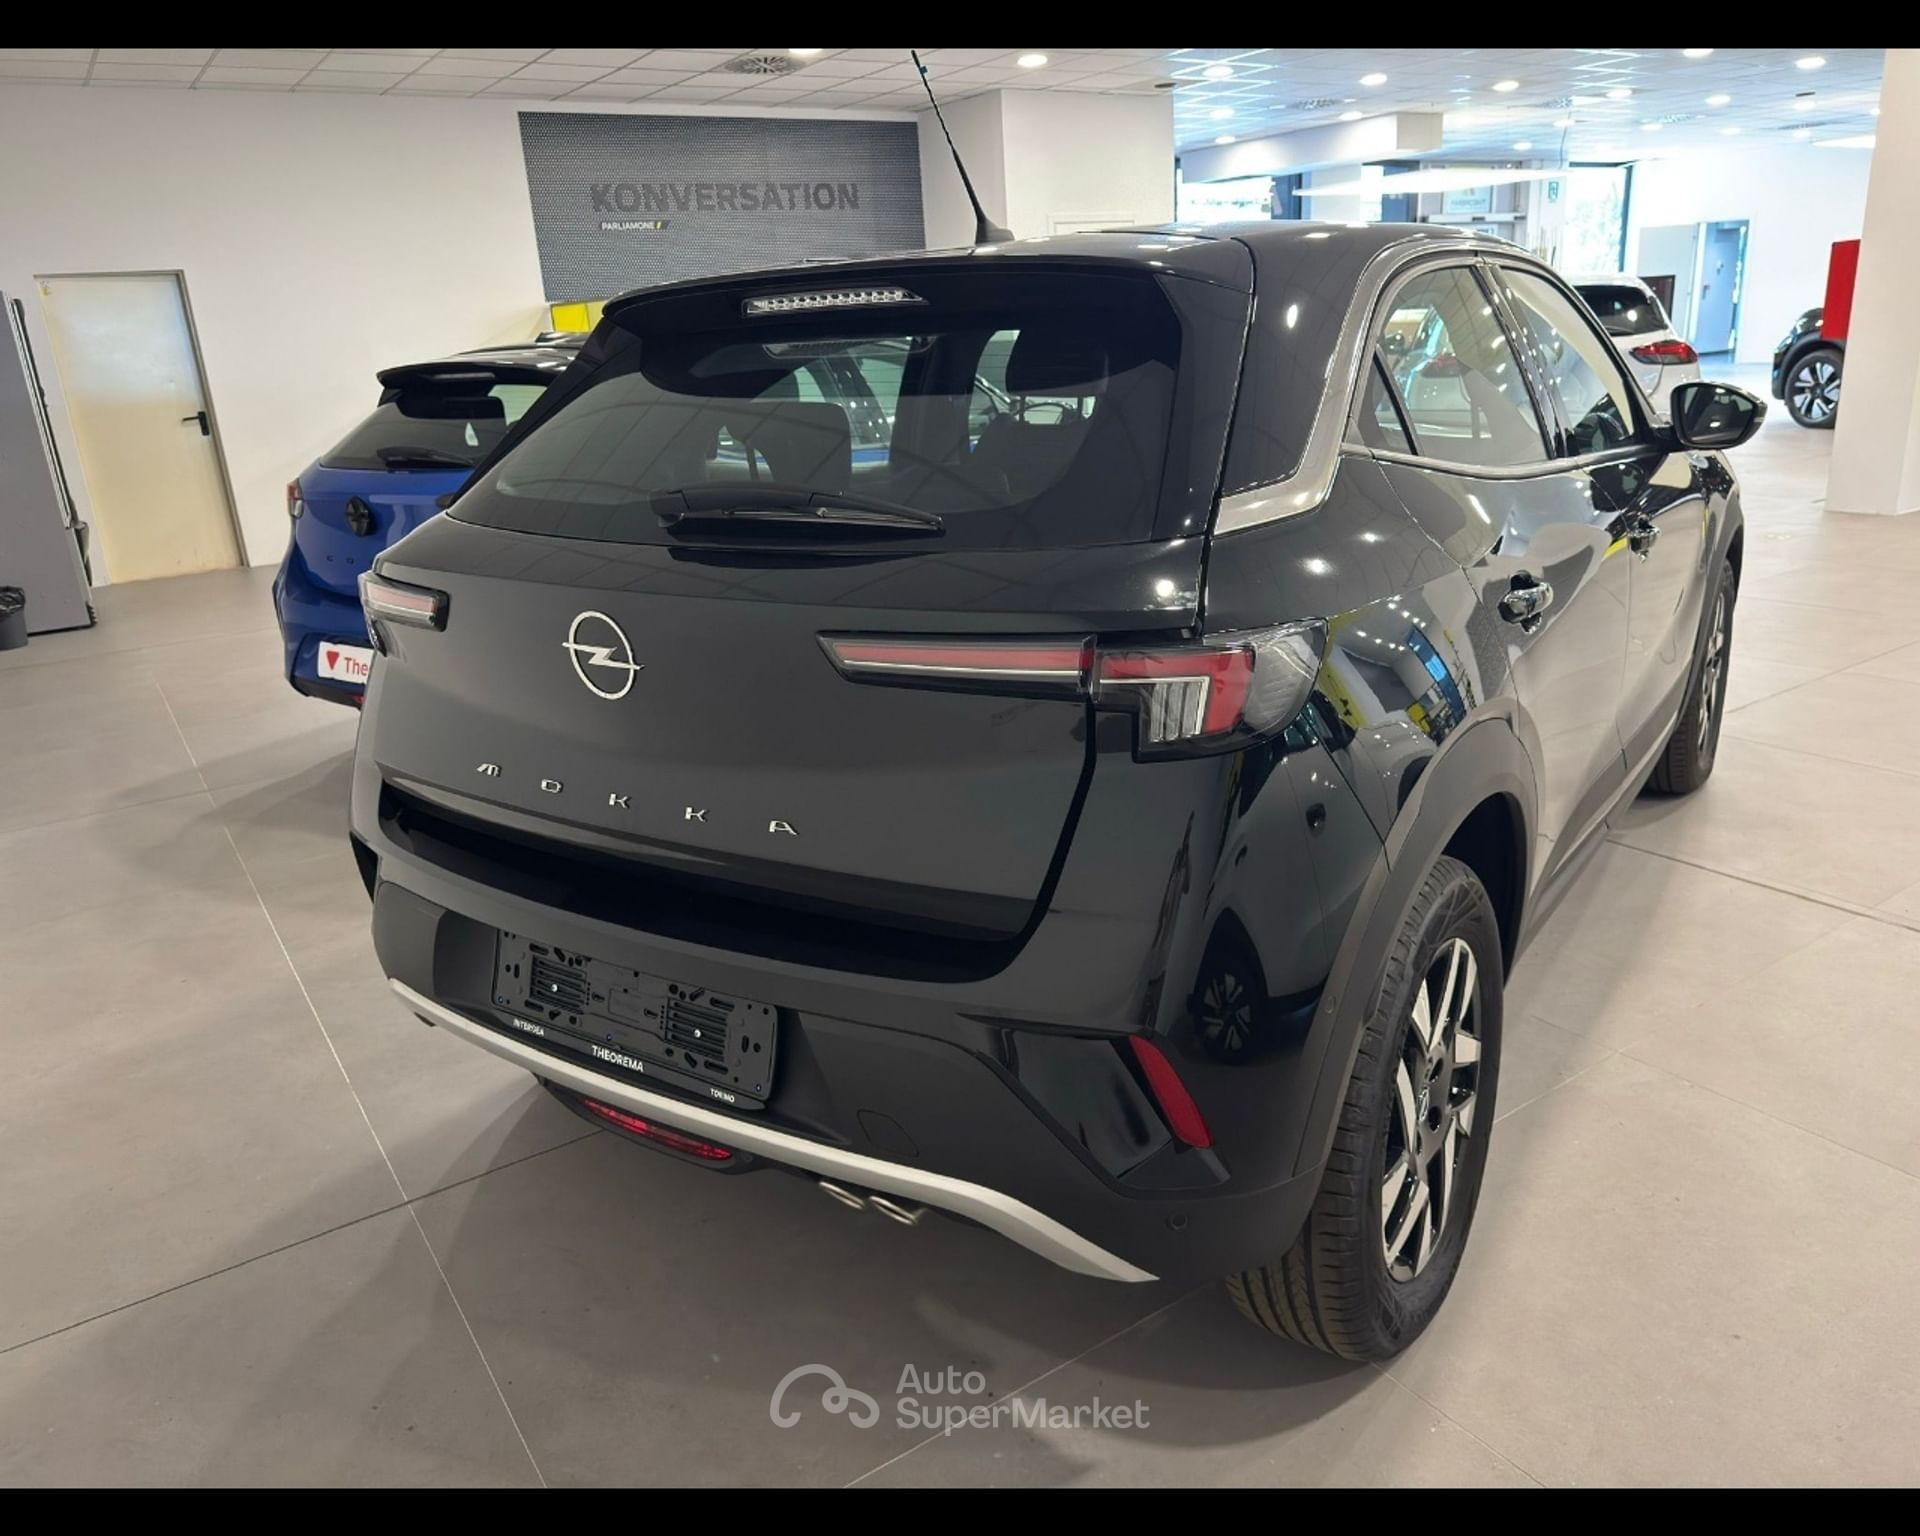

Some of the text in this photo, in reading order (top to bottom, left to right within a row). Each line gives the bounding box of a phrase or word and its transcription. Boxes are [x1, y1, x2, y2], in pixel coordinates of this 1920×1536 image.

[591, 182, 860, 212] KONVERSATION
[601, 222, 656, 231] PARLIAMONE
[477, 763, 797, 835] MOKKA
[592, 1045, 644, 1073] THEOREMA
